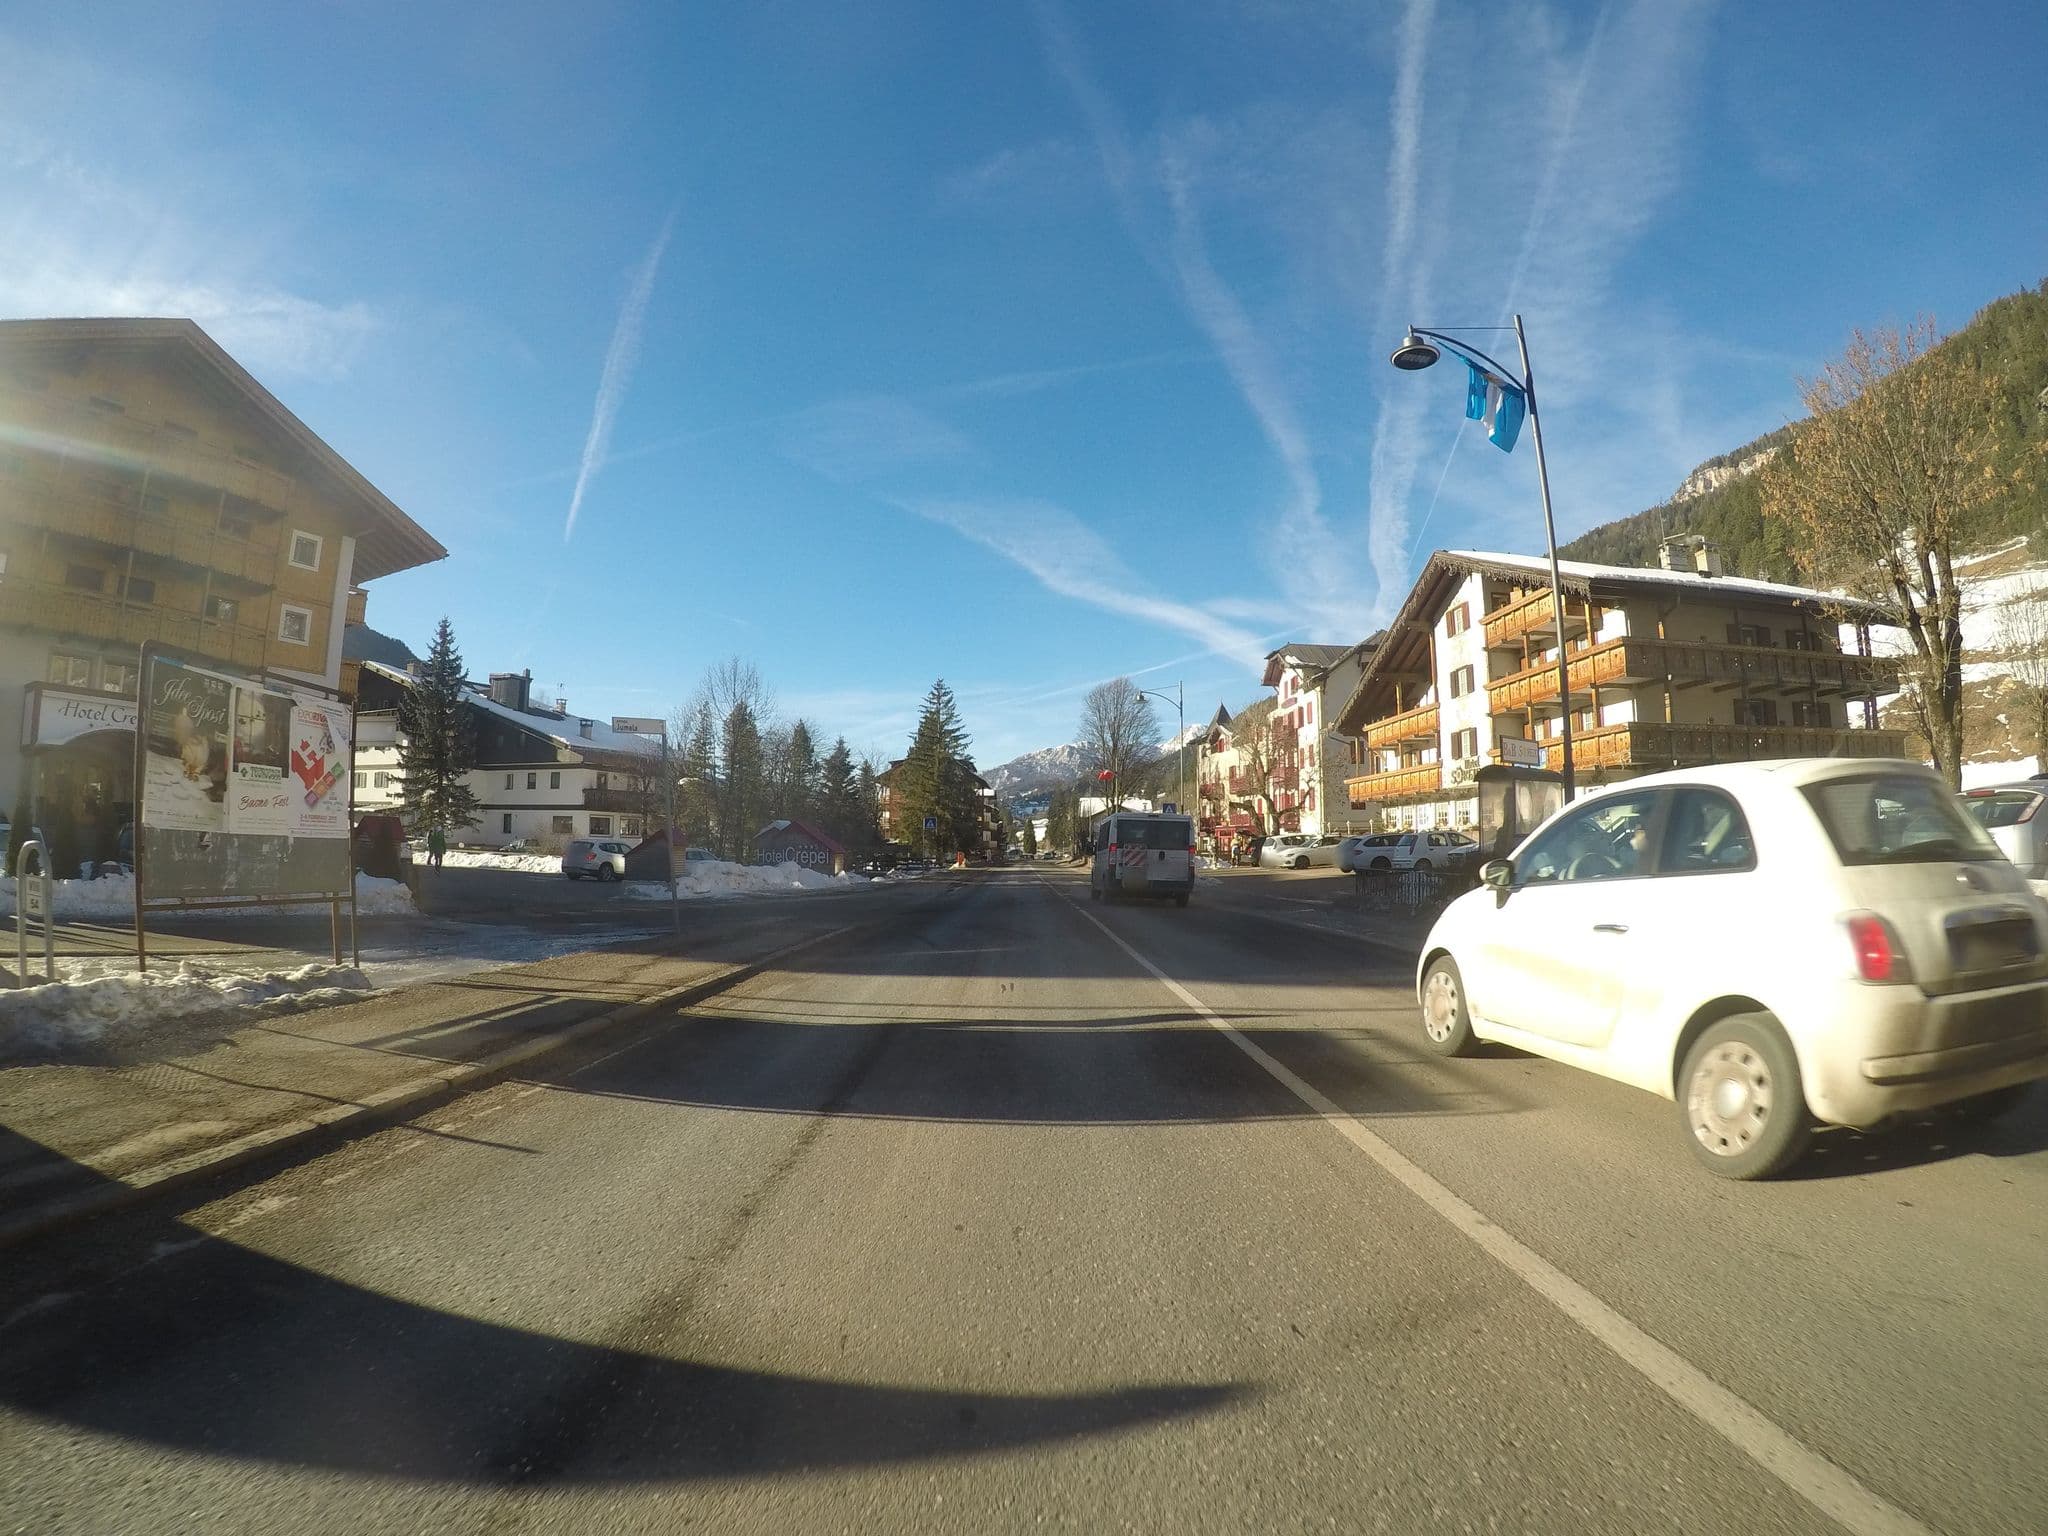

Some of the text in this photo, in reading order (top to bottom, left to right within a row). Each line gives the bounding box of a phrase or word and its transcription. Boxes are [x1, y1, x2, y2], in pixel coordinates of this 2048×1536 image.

[58, 701, 106, 721] Hotel
[111, 705, 137, 725] Cre
[272, 794, 289, 808] Fest
[757, 848, 785, 863] Hotel
